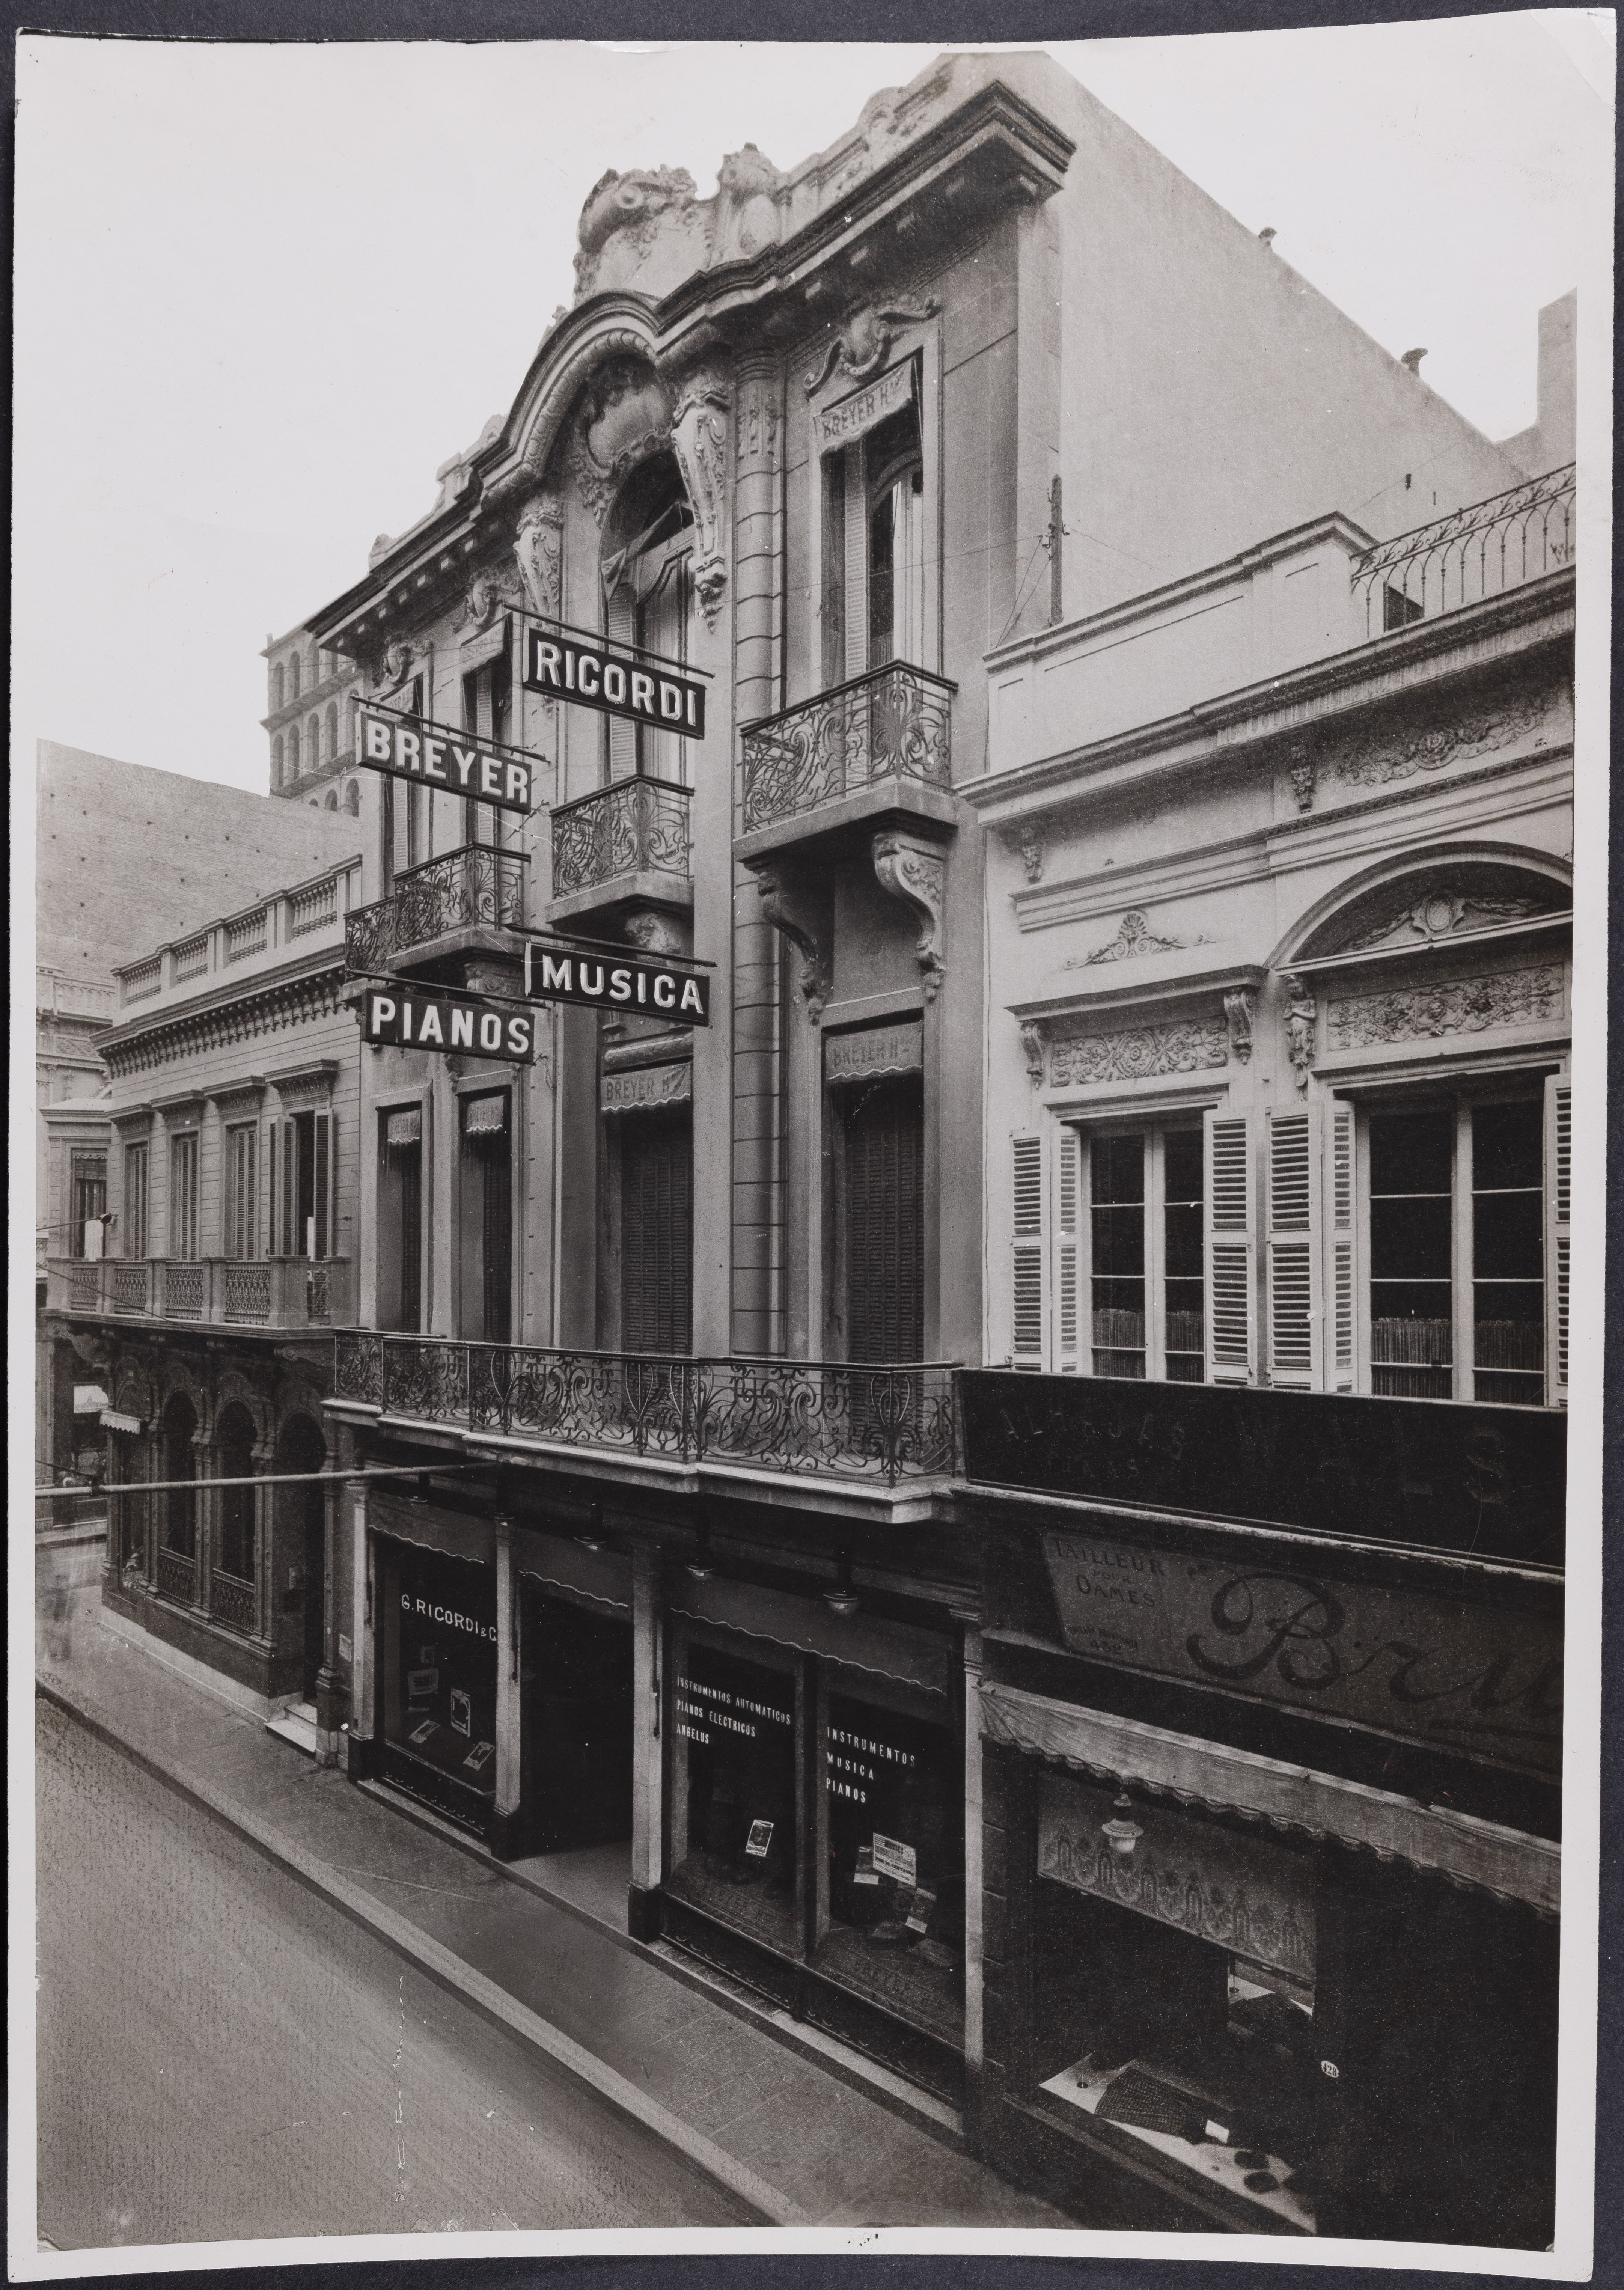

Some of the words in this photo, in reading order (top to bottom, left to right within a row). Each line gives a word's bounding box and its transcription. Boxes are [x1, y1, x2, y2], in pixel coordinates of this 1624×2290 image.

[536, 640, 697, 726] RICORDI
[368, 719, 529, 804] BREYER
[543, 954, 703, 1014] MUSICA
[372, 996, 530, 1053] PIANOS
[607, 1077, 654, 1101] BREYER
[1051, 1538, 1165, 1576] TAILLEUR
[676, 1699, 703, 1718] PIANOS
[709, 1711, 755, 1737] ELECTRICOS
[677, 1676, 731, 1704] INSTRUMENTOS
[735, 1696, 791, 1725] AUTOMATICOS
[676, 1723, 710, 1744] ANGELUS
[827, 1726, 916, 1767] INSTRUMENTOS
[827, 1752, 874, 1780] MUSICA
[826, 1777, 866, 1803] PIANOS
[1323, 2063, 1337, 2077] 428
